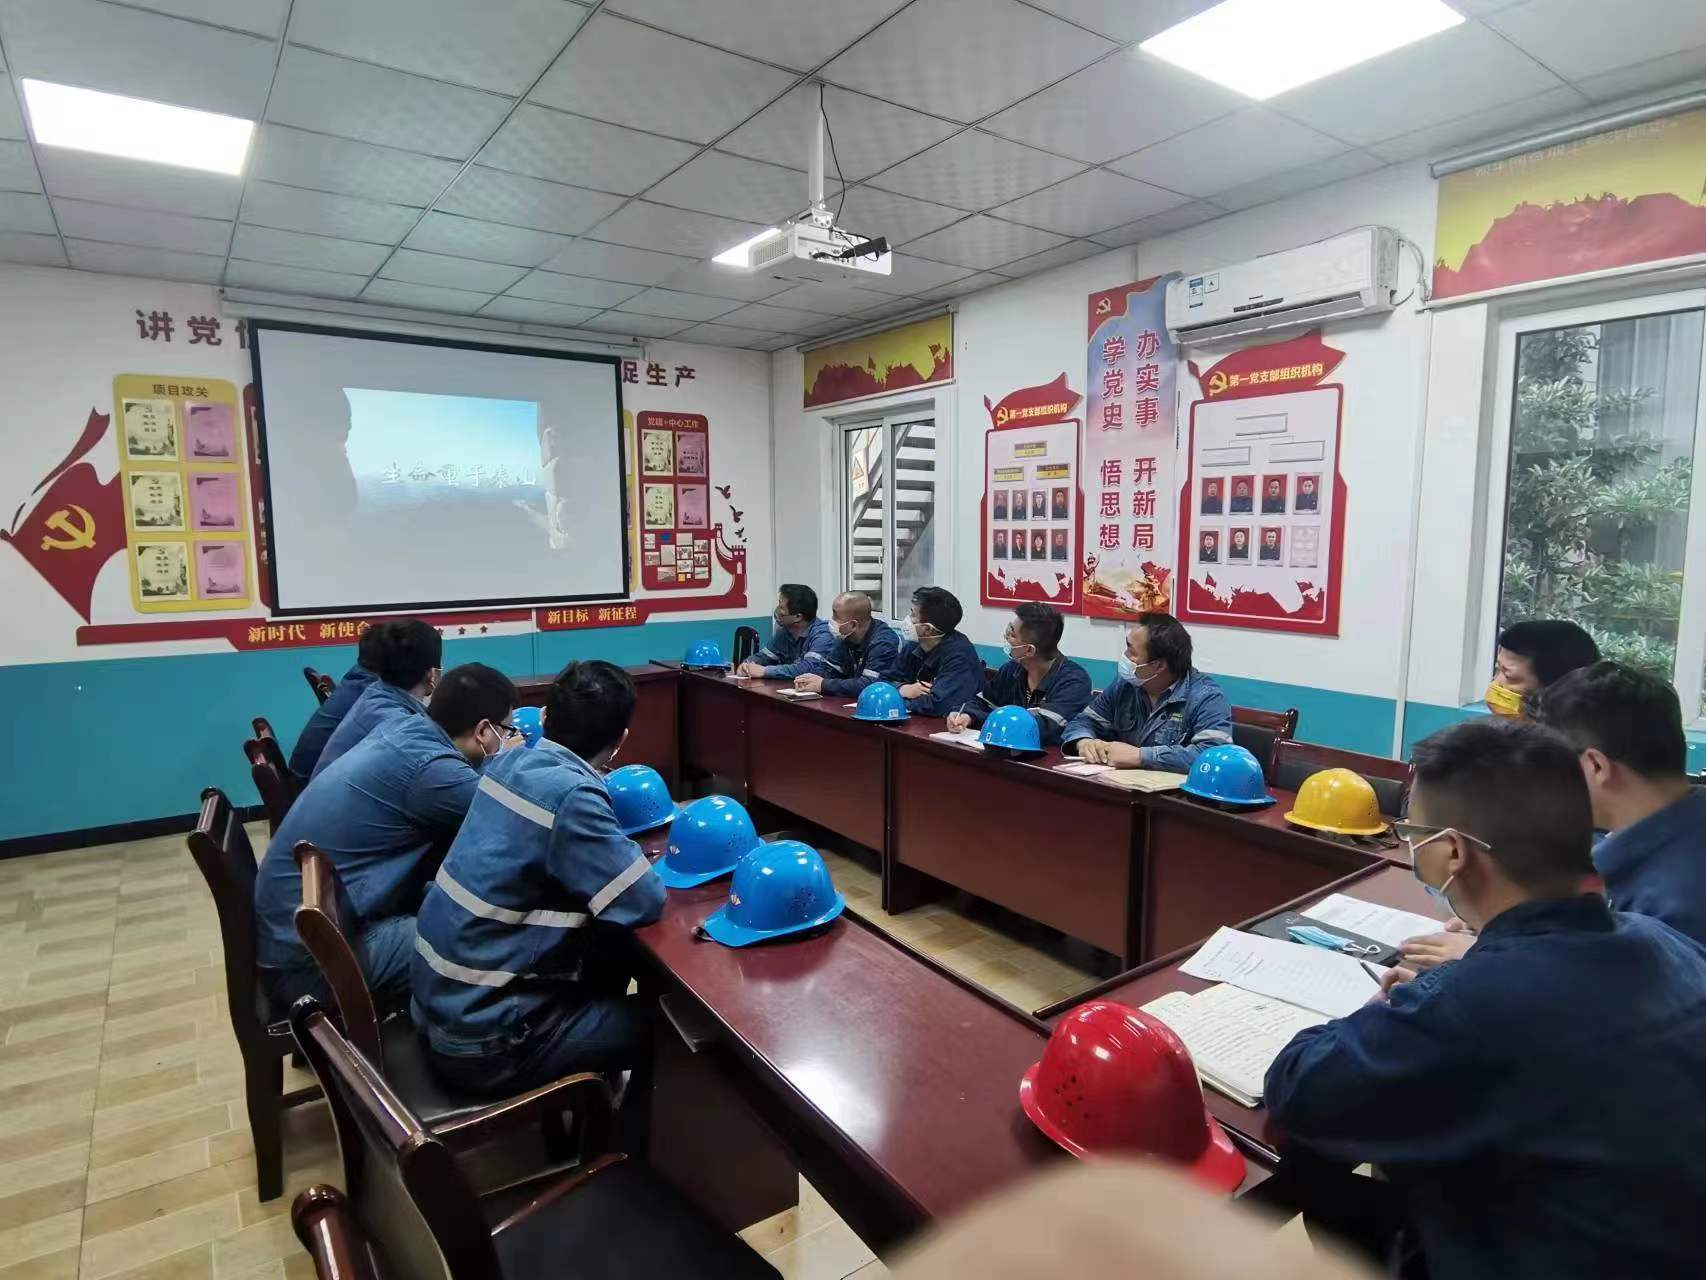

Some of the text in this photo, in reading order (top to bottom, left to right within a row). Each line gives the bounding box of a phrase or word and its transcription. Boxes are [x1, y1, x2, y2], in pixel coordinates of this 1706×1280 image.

[1229, 363, 1324, 387] 第一党支部组织机构
[152, 384, 209, 397] 项目攻关
[1009, 403, 1068, 419] 第一党支部组织机构
[1099, 336, 1125, 549] 学党史 悟思想
[1132, 330, 1160, 549] 办实事 开新局
[547, 606, 637, 625] 新目标 新征程
[248, 624, 306, 642] 新时代
